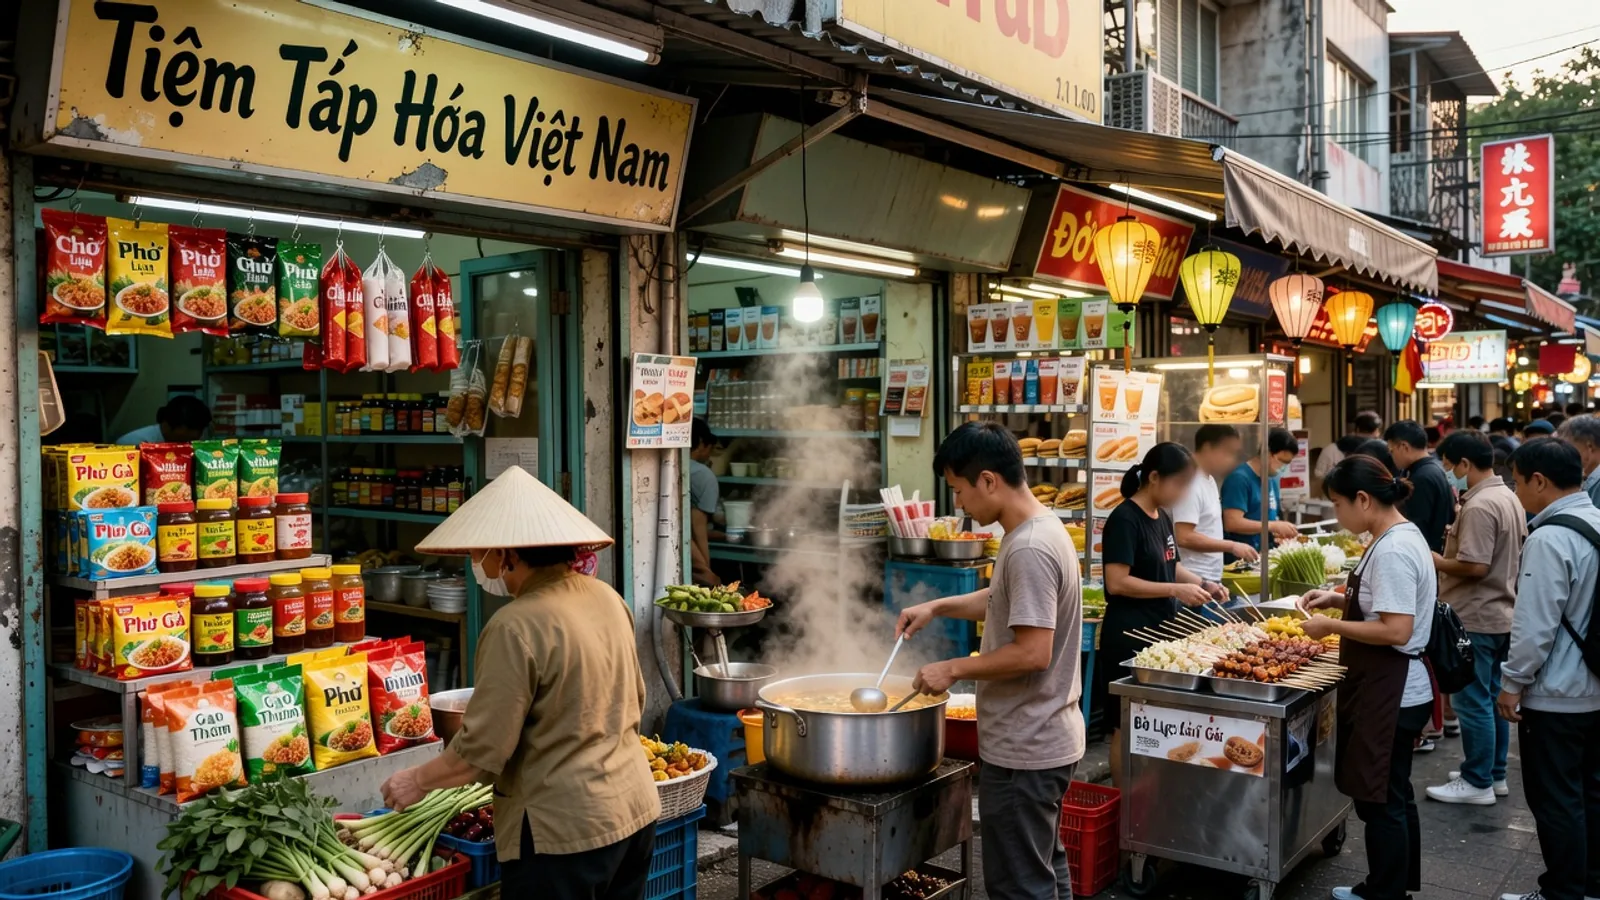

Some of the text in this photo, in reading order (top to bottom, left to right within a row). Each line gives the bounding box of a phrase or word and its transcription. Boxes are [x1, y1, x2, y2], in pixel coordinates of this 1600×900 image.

[94, 2, 256, 128] Tiệm
[503, 94, 584, 187] Việt
[588, 115, 671, 192] Nam
